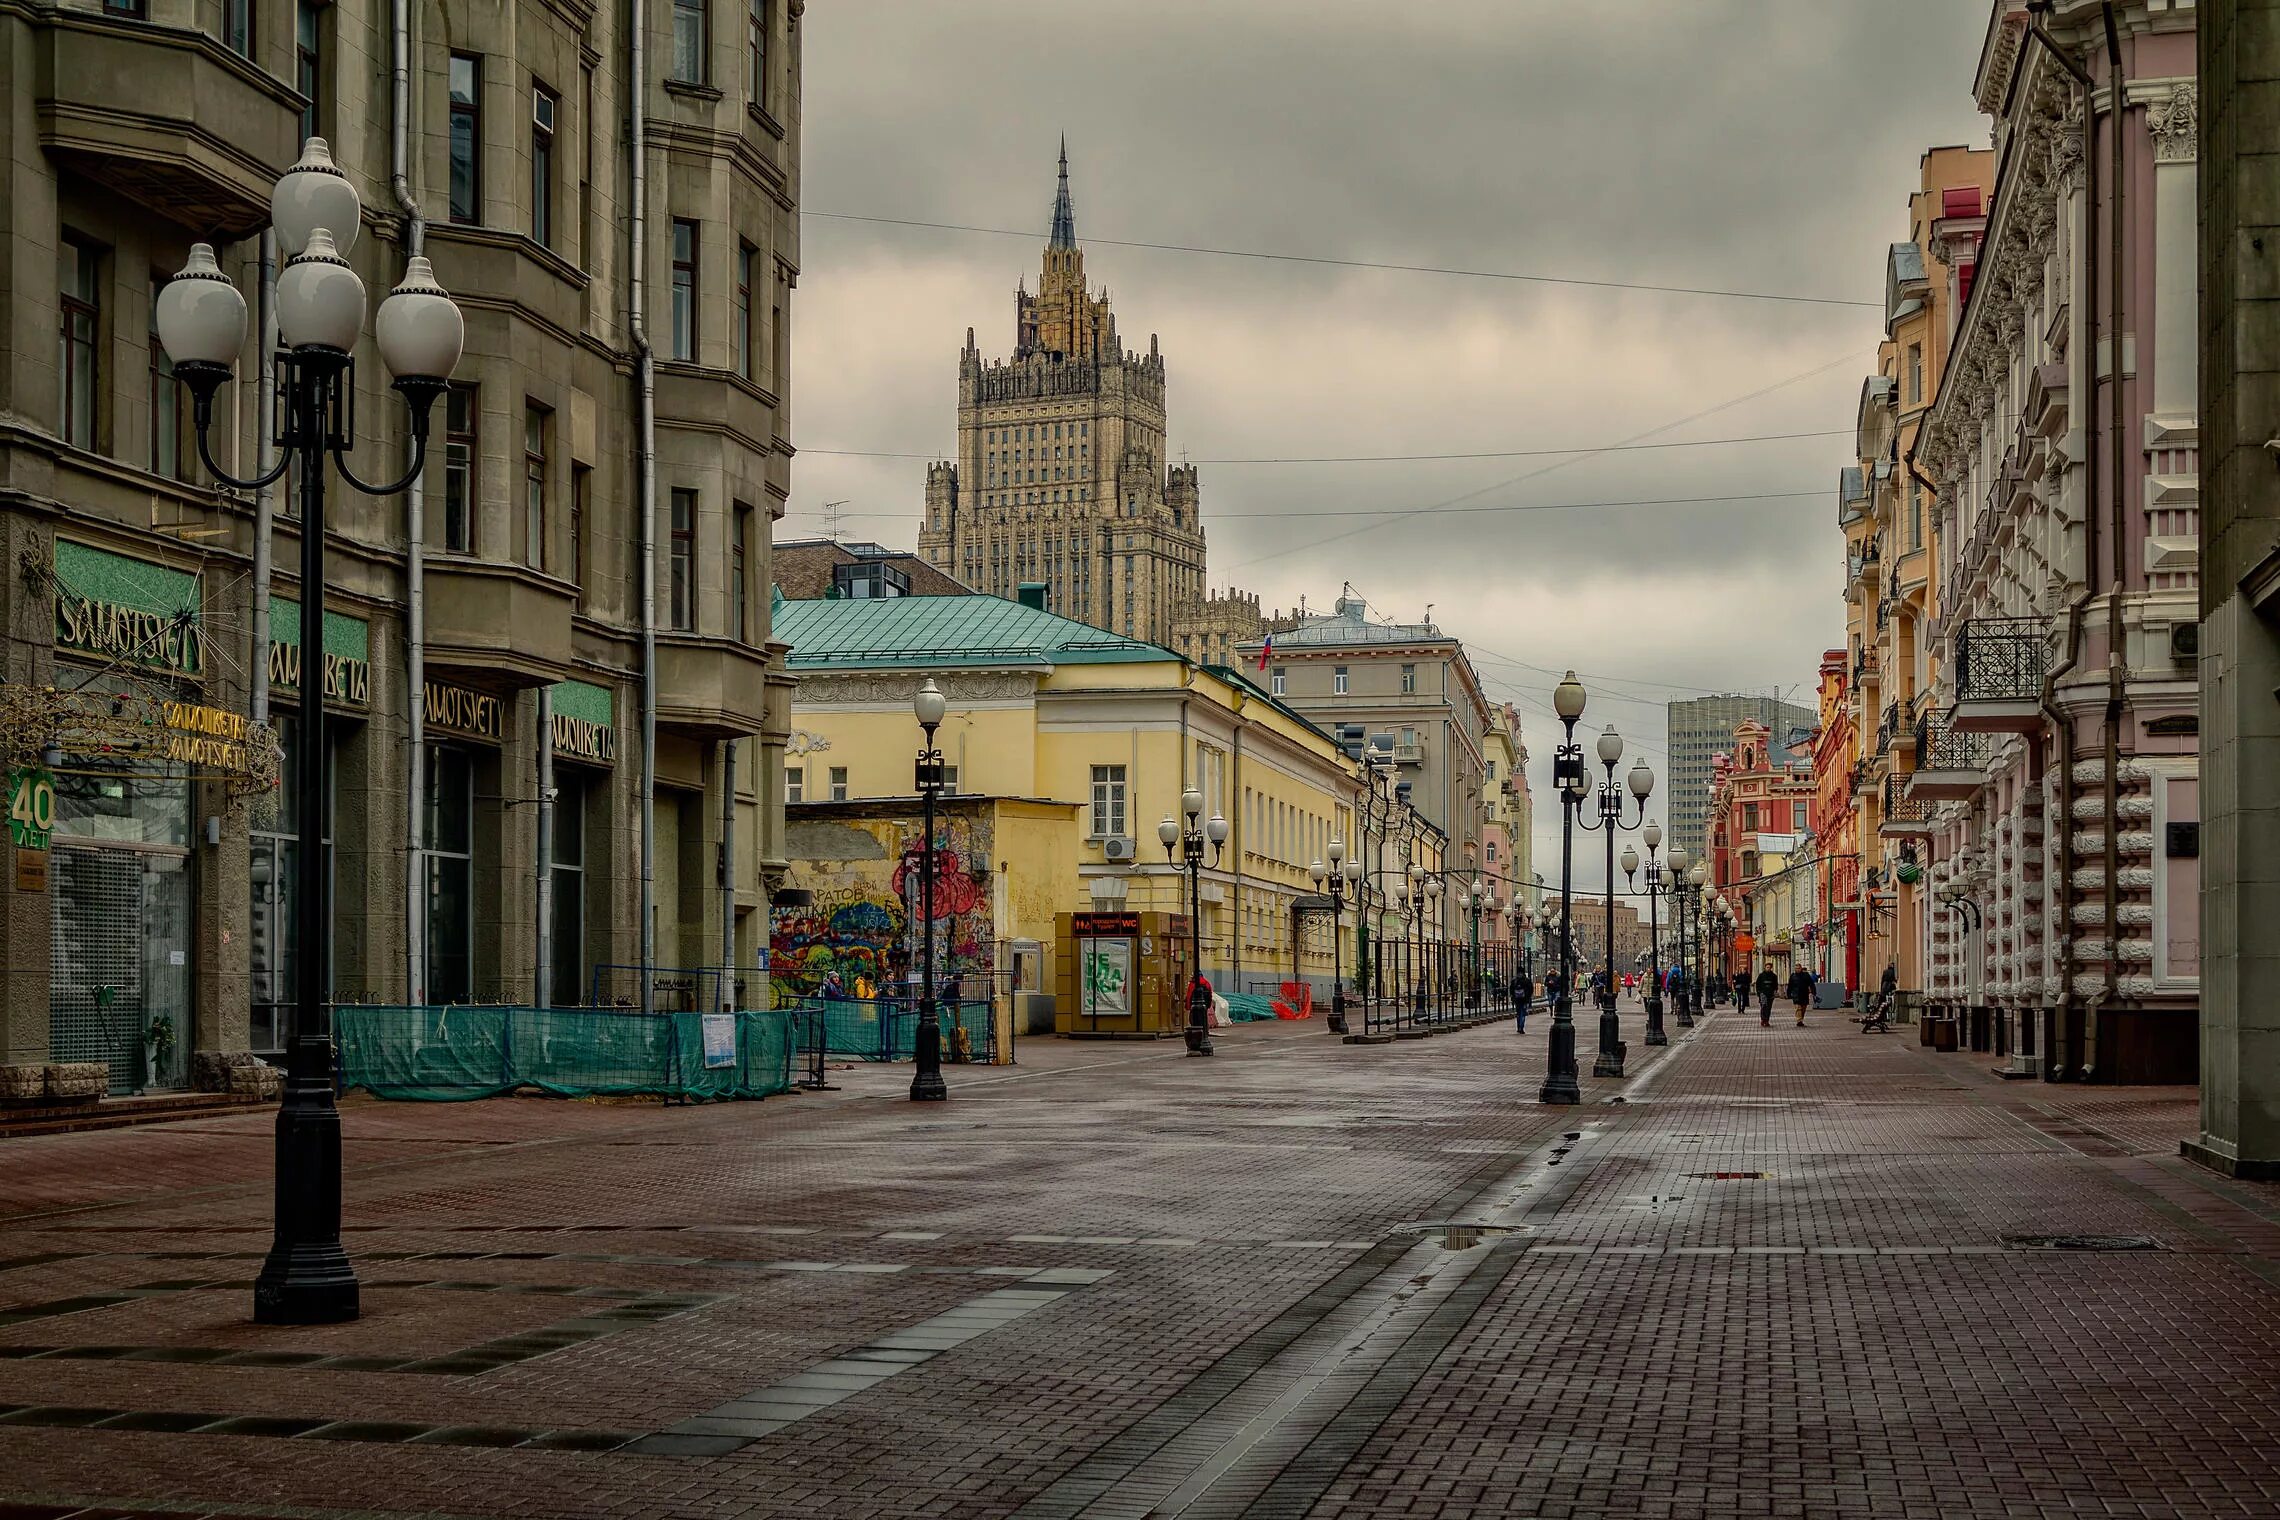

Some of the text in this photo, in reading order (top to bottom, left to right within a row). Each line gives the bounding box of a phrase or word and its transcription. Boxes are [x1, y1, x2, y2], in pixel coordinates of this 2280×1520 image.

[268, 640, 371, 703] АМВЕТЫ
[423, 682, 505, 738] AMOTSVETY
[550, 712, 616, 761] АМОЦВЕТЫ
[12, 777, 55, 830] 40
[18, 828, 49, 849] ЛЕТ
[1121, 919, 1137, 928] WC
